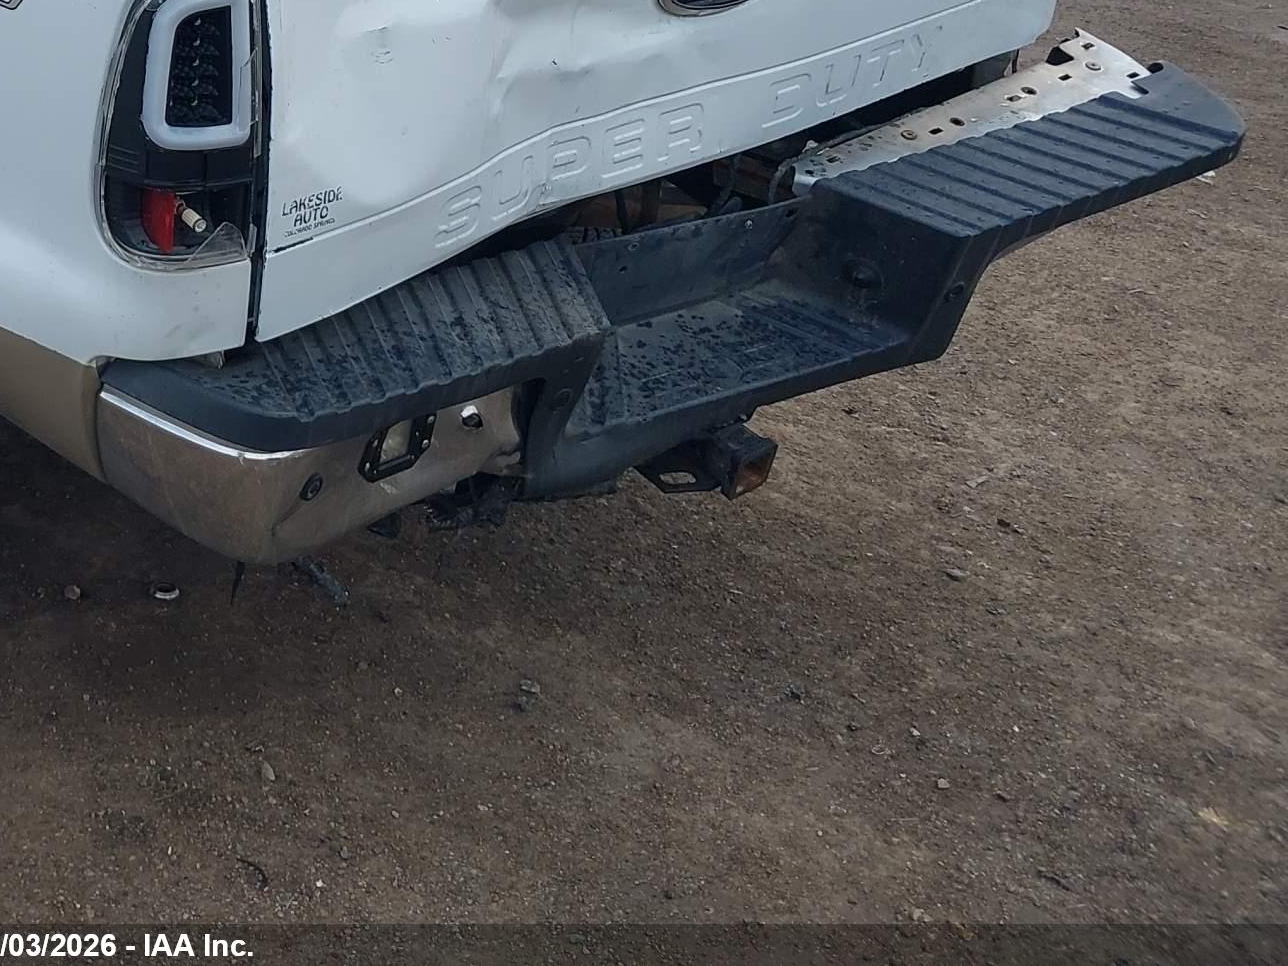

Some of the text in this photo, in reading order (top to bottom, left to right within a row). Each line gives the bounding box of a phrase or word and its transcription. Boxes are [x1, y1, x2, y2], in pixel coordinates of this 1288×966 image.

[434, 25, 943, 248] SUPER DUTY
[281, 186, 343, 217] LAKESIDE
[294, 206, 329, 227] AUTO
